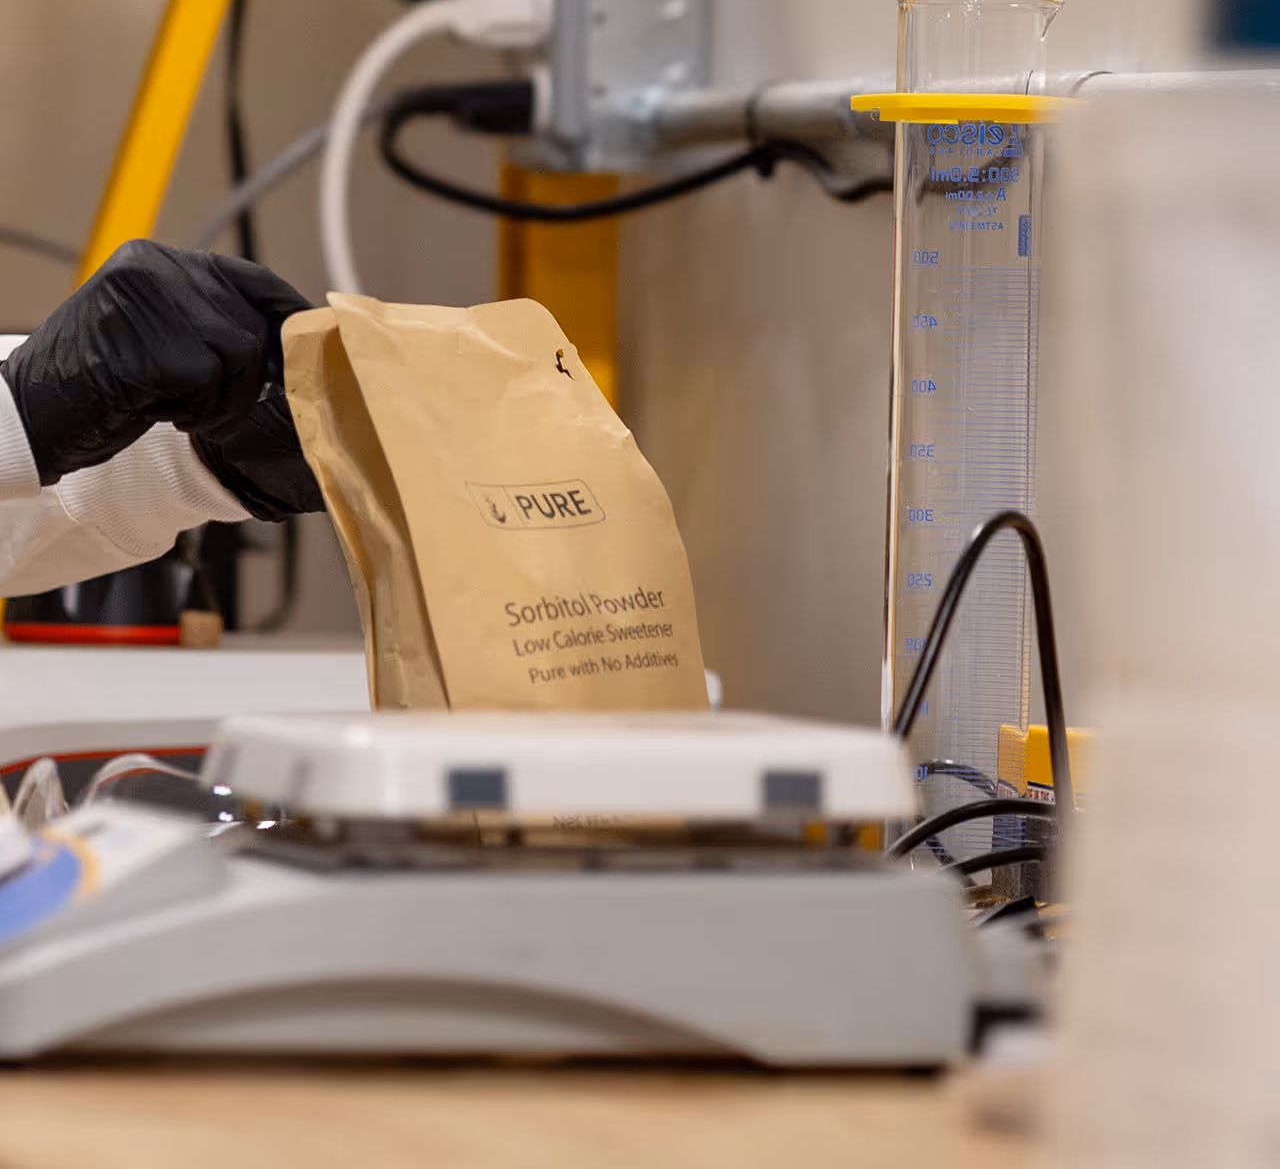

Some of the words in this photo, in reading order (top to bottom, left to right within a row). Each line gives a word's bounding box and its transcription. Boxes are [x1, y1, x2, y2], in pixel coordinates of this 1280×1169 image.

[514, 489, 593, 520] PURE
[504, 592, 592, 627] Sorbitol
[589, 586, 665, 615] Powder
[512, 637, 551, 657] Low
[552, 626, 605, 650] Calorie
[606, 621, 675, 644] Sweetener
[528, 665, 567, 685] Pure
[568, 657, 600, 677] with
[601, 656, 622, 672] No
[624, 650, 679, 670] Additives
